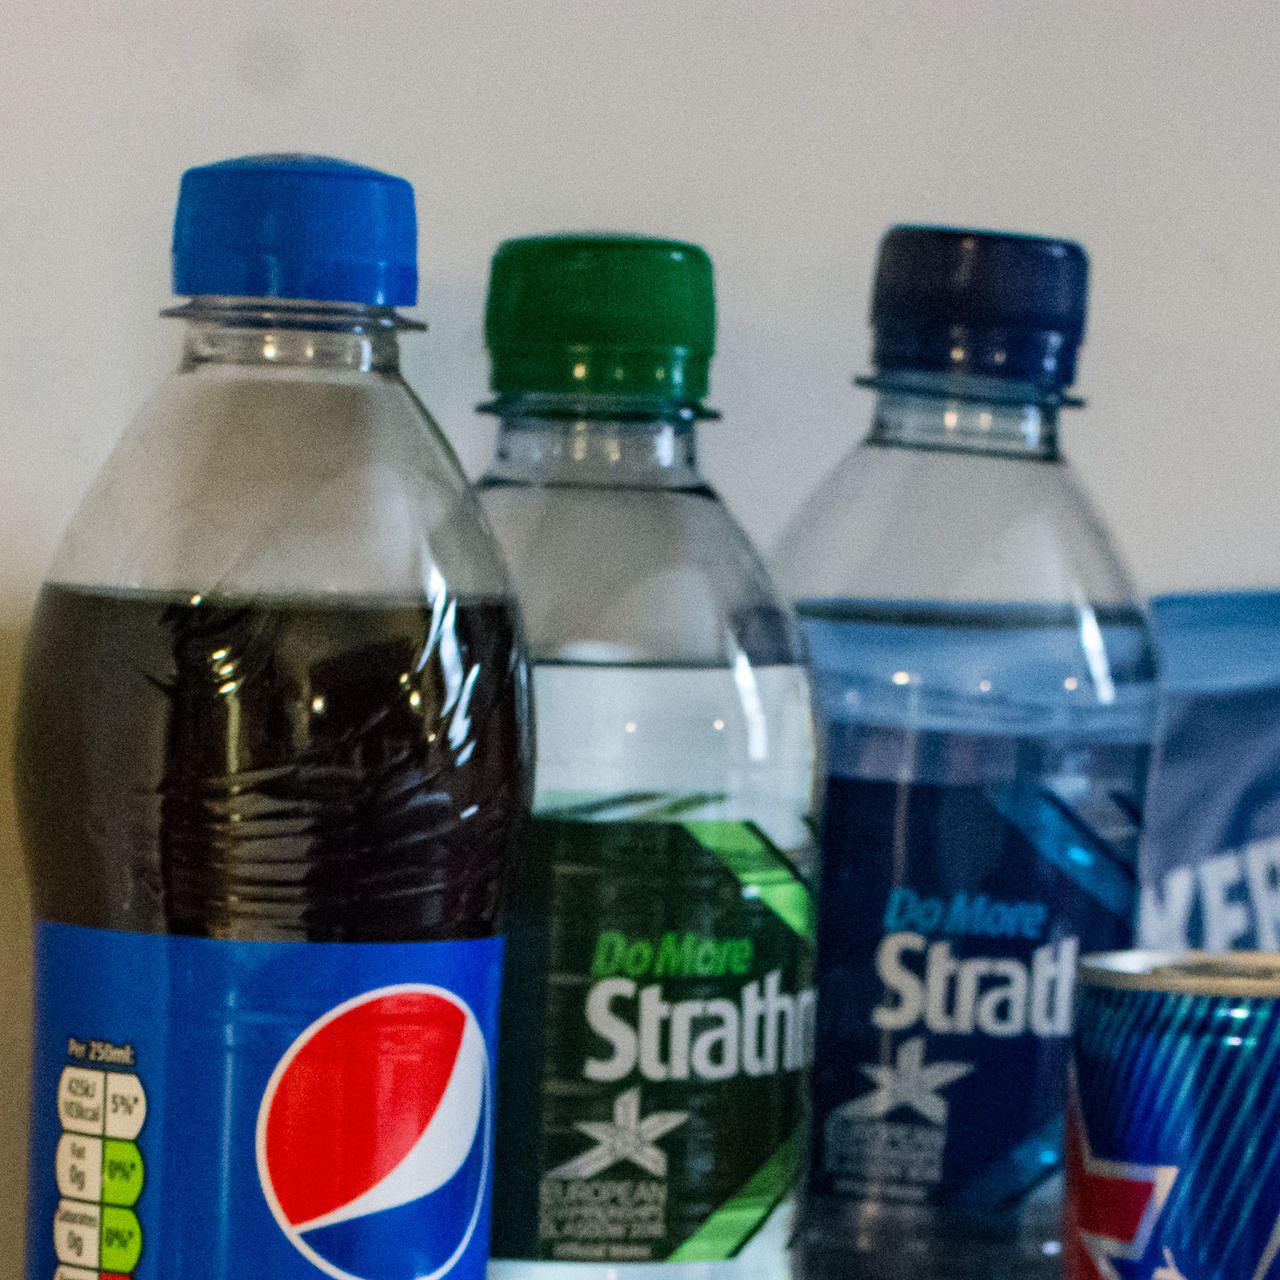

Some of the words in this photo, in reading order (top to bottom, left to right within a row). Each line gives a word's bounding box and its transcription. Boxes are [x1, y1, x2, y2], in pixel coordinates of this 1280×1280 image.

[882, 886, 944, 935] Do
[944, 890, 1049, 939] More
[591, 930, 653, 977] Do
[655, 931, 754, 977] More
